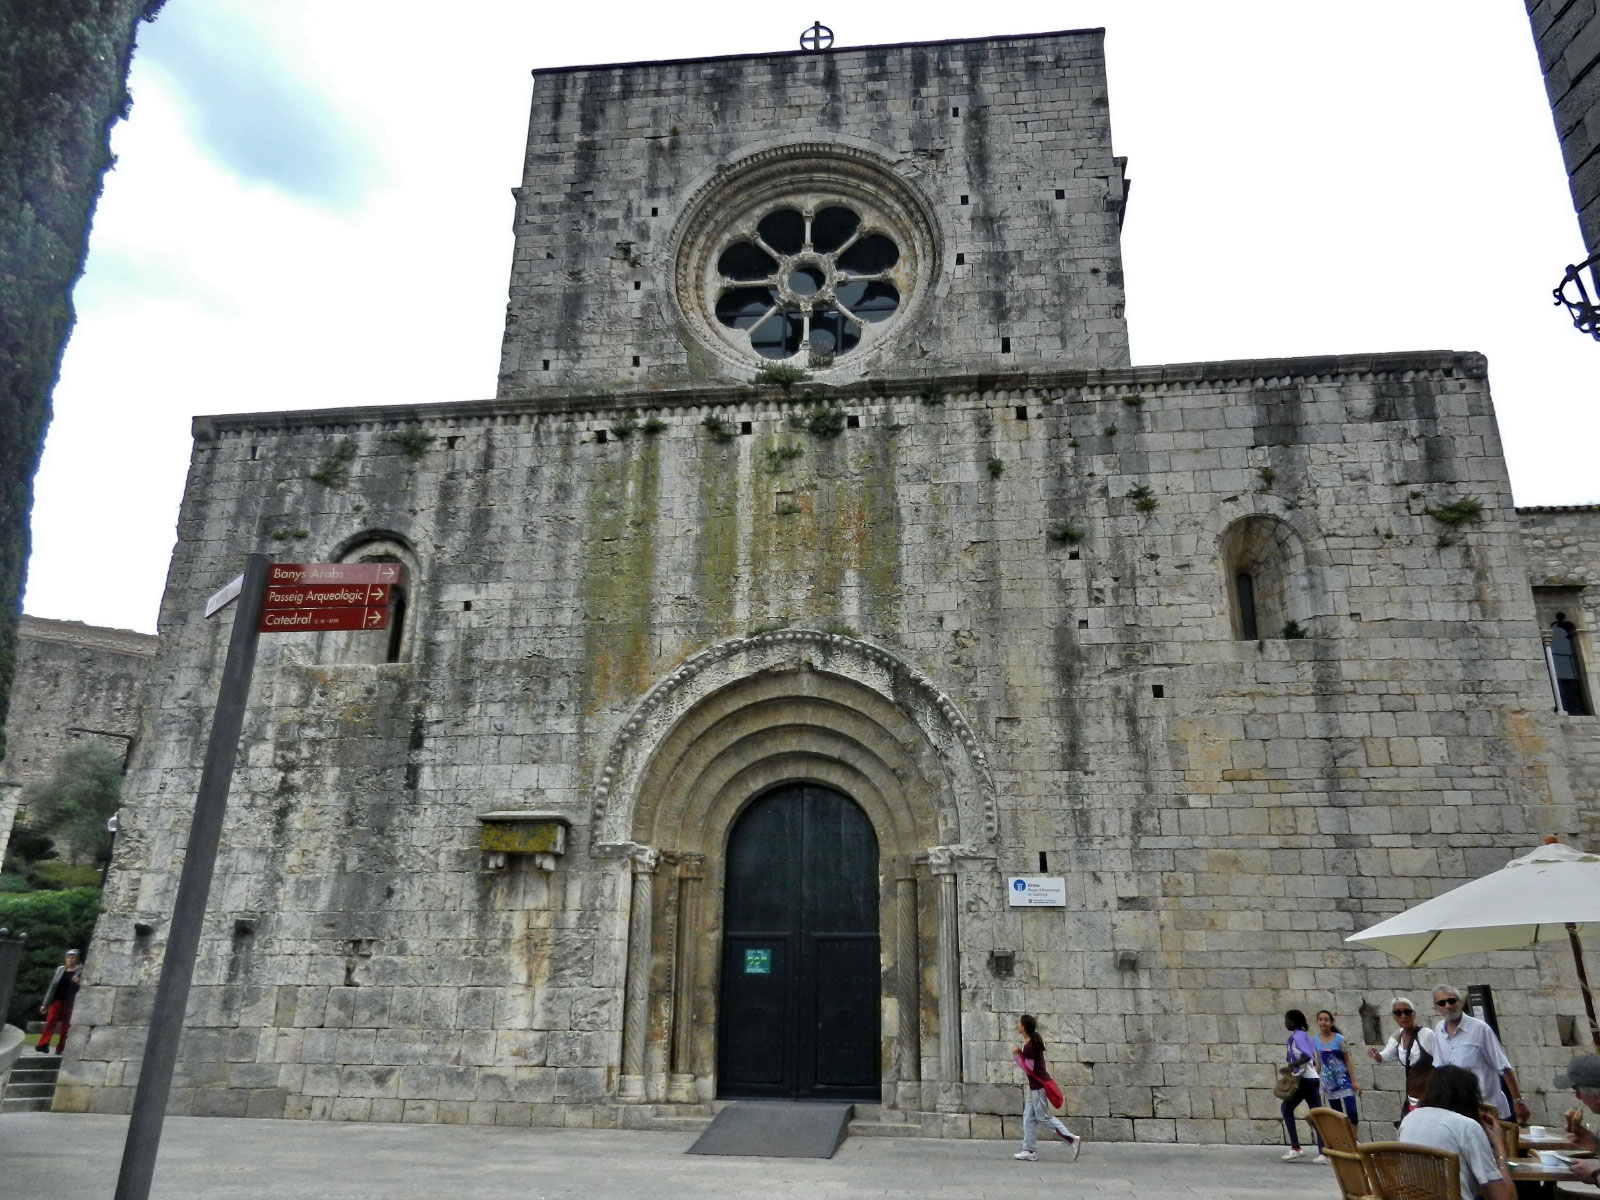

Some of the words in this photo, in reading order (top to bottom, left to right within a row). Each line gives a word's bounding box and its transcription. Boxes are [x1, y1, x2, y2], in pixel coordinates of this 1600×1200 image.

[274, 568, 307, 582] Banys
[311, 568, 344, 580] Arabs
[269, 591, 304, 604] Passeig
[306, 589, 364, 604] Arqueològic
[265, 612, 313, 626] Catedral
